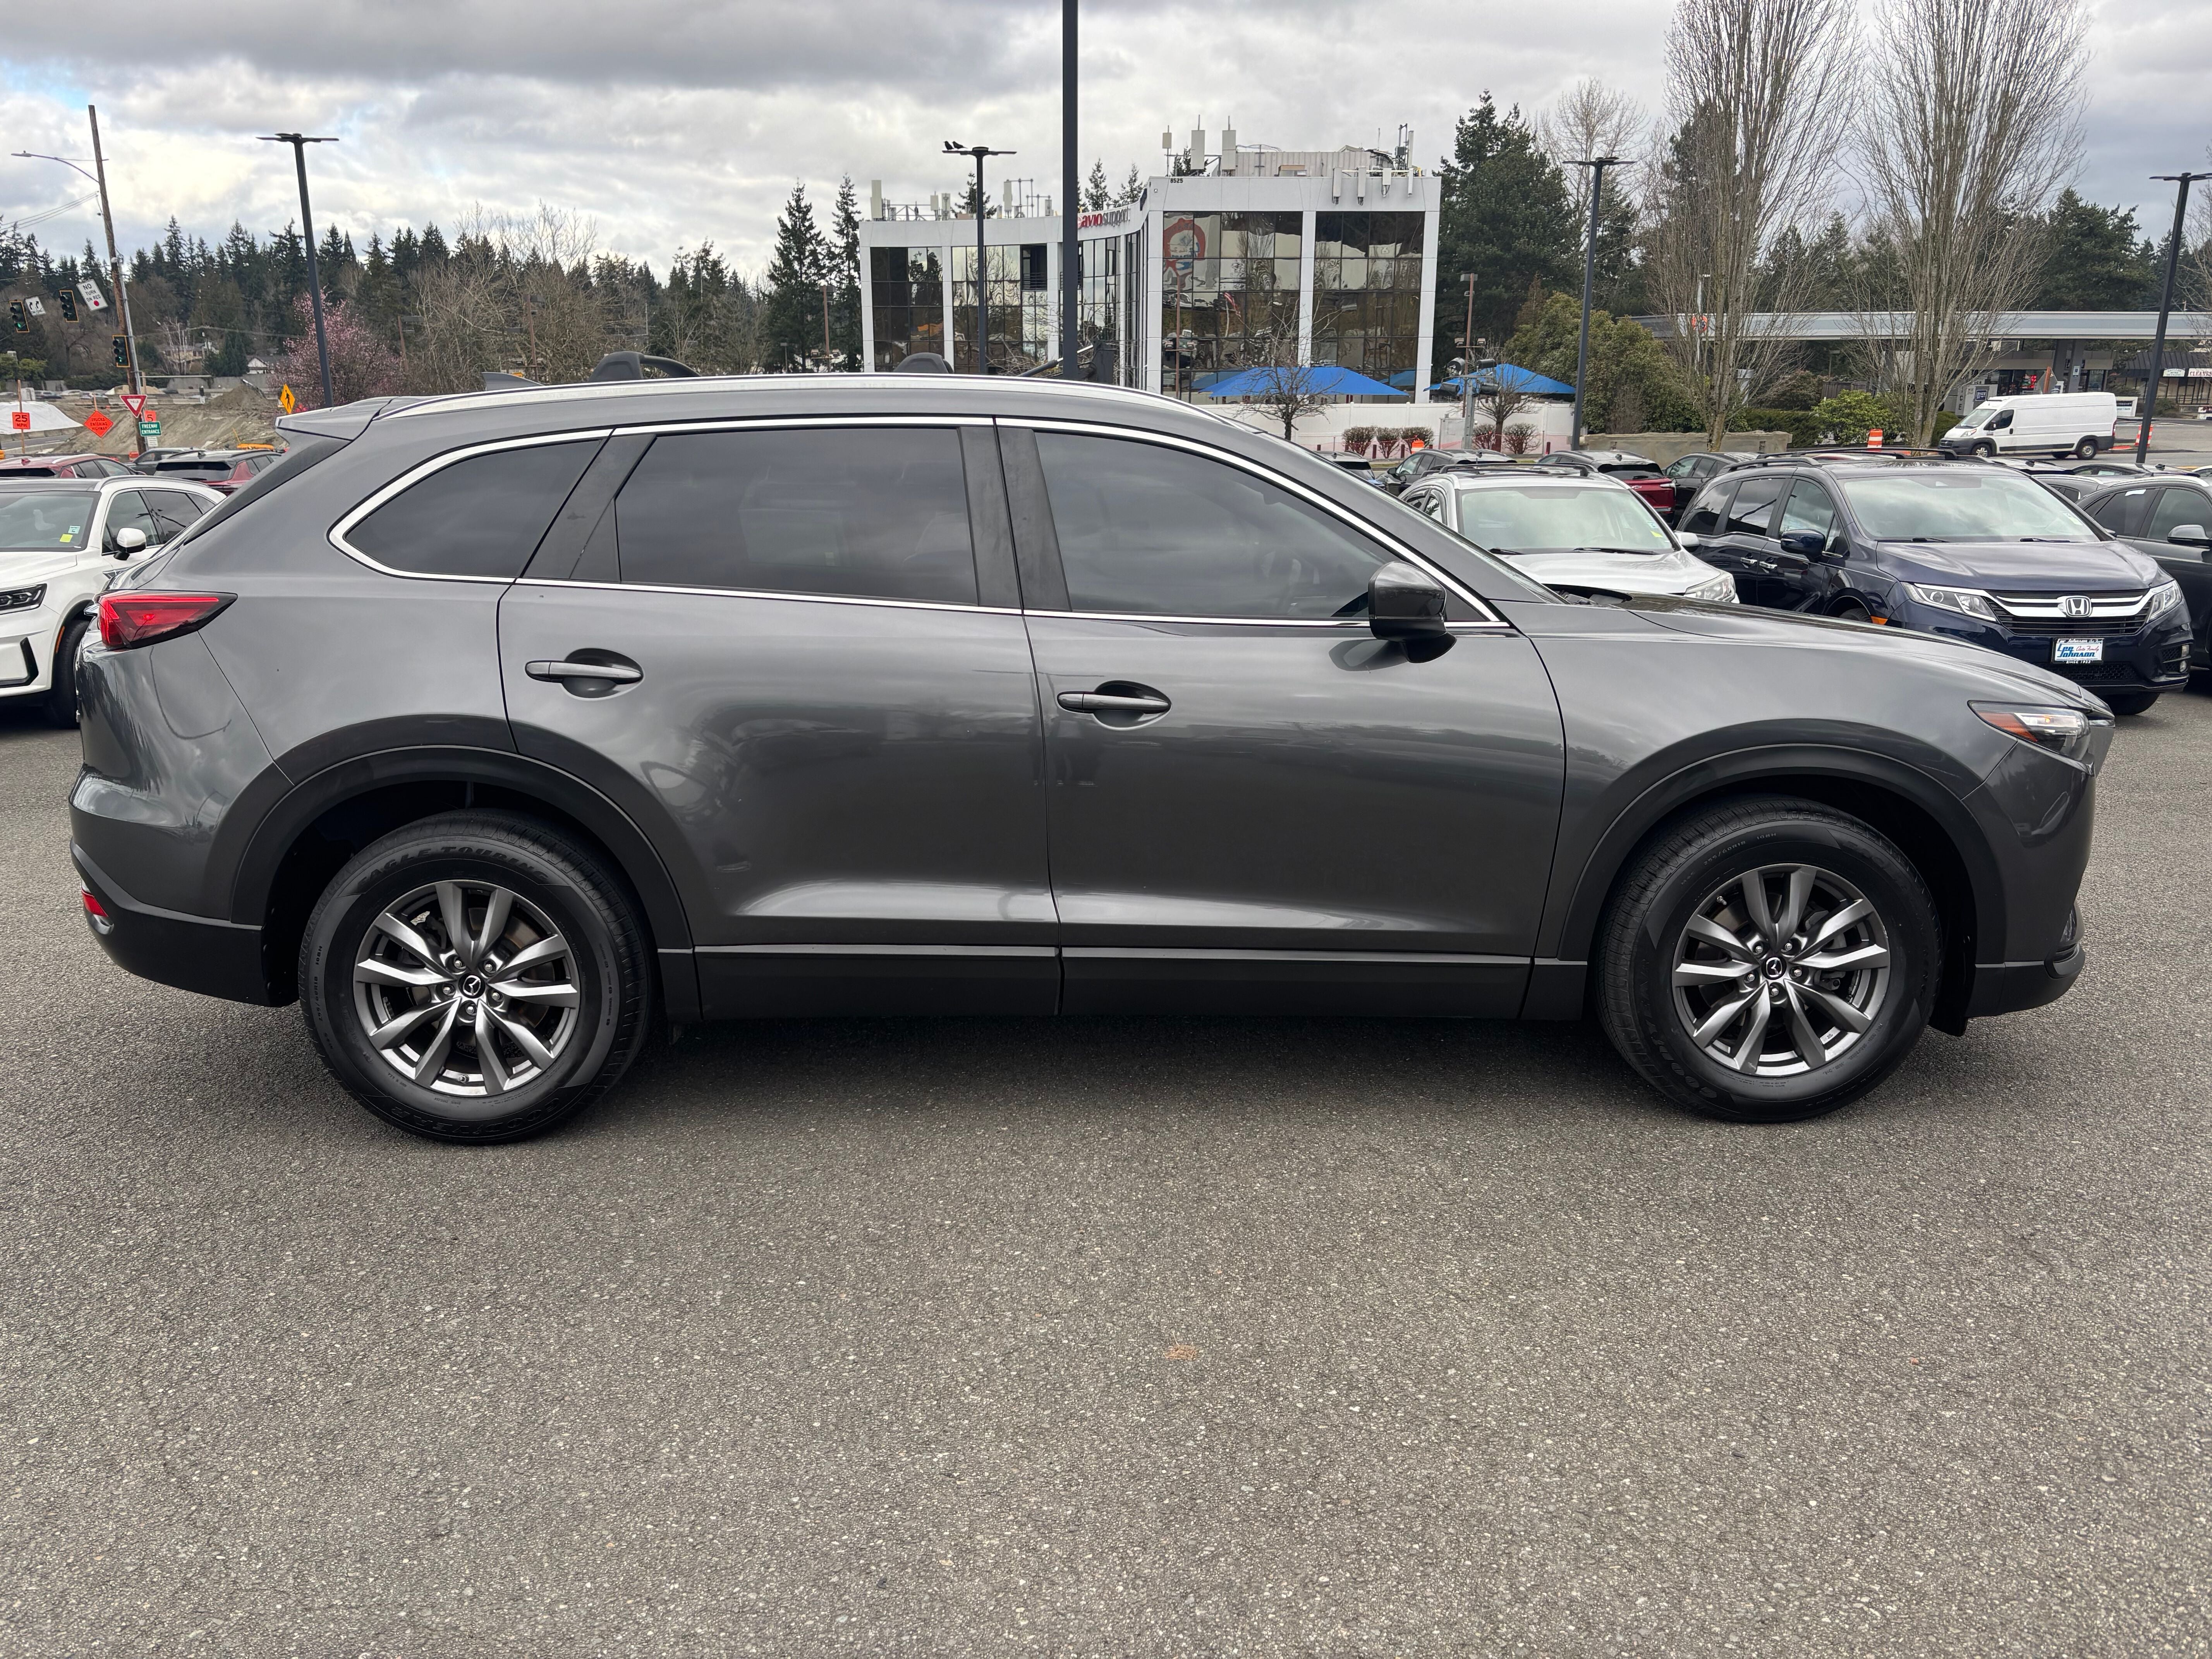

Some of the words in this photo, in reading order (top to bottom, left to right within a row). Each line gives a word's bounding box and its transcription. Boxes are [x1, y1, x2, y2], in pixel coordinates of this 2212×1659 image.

[2057, 643, 2075, 651] Lee
[357, 848, 431, 888] EAGLE
[441, 847, 549, 882] TOURING
[1703, 841, 1746, 865] 255/60R18
[390, 1098, 560, 1135] GOODYEAR
